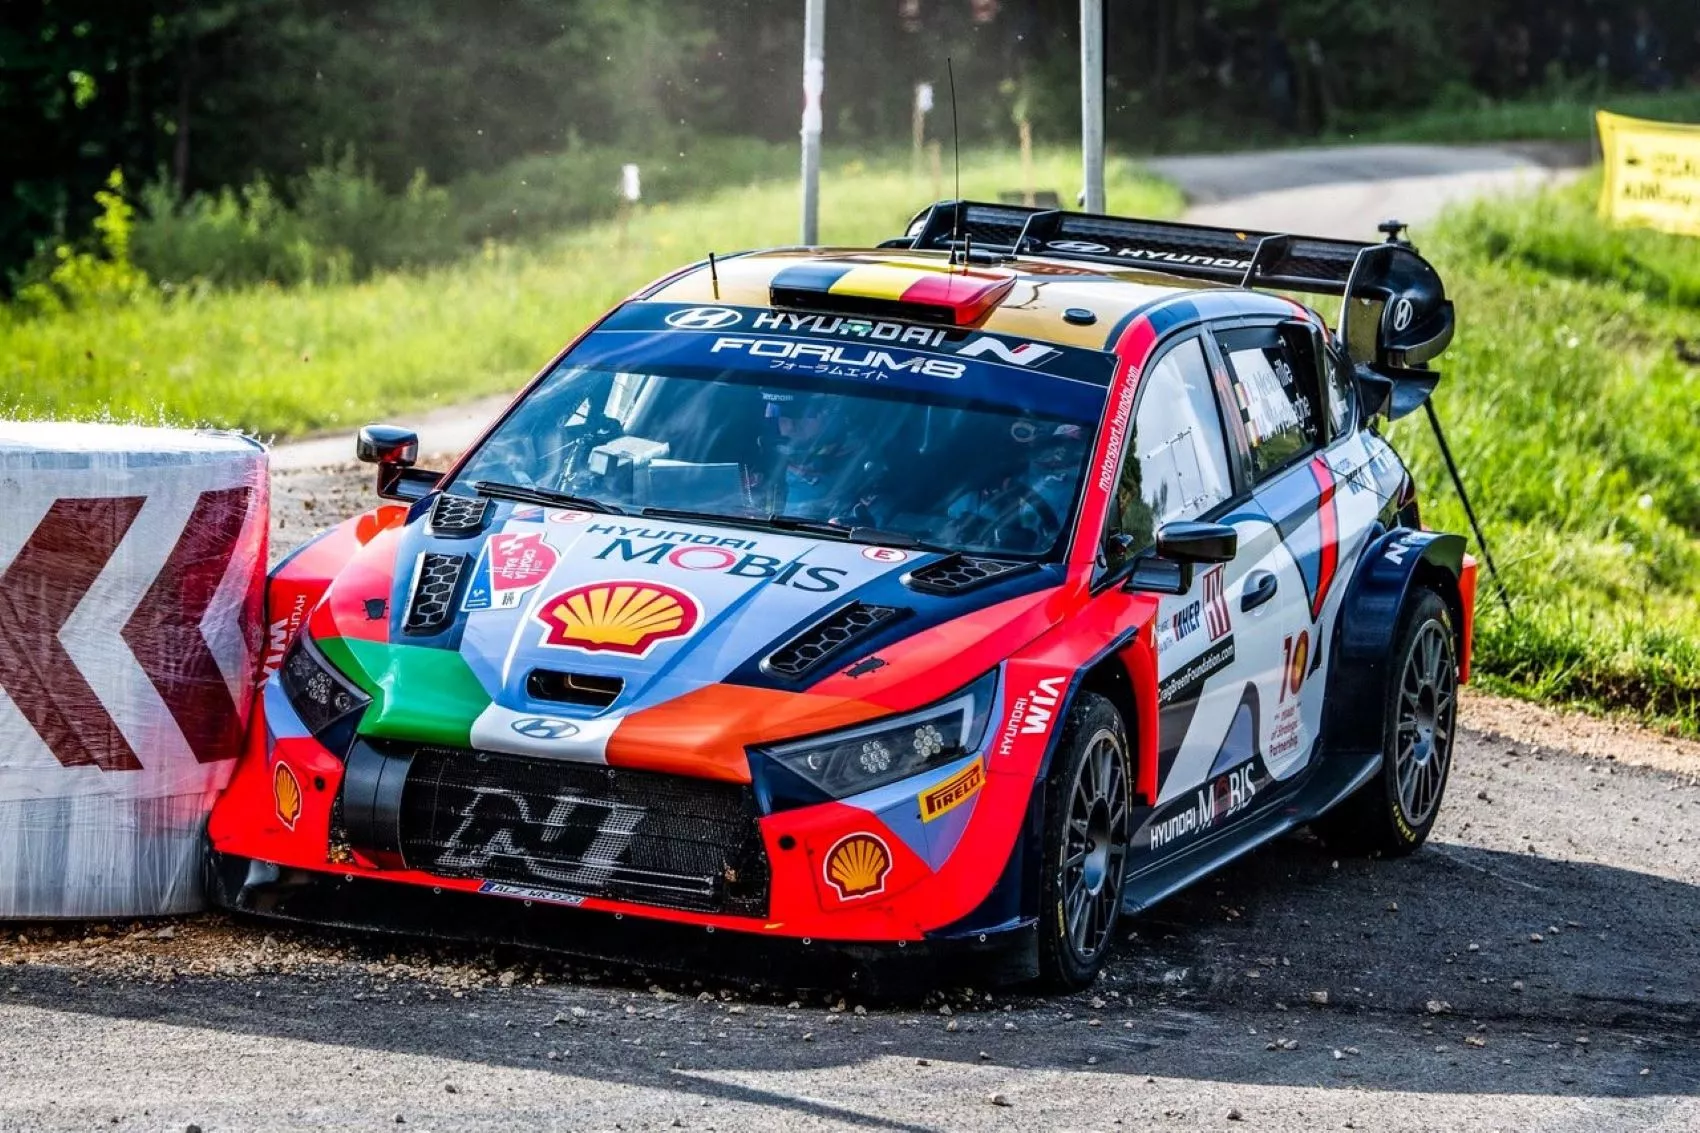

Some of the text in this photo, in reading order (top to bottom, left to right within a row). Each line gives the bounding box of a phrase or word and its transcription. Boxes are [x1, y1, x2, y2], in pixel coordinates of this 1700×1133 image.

[752, 311, 947, 348] HYUNDAI
[711, 337, 967, 380] FORUM8
[769, 359, 890, 380] フォーラムエイト
[1099, 364, 1139, 494] motorsport.hyundai.com
[587, 523, 758, 551] HYUNDAI
[593, 538, 850, 593] MOBIS
[1000, 697, 1027, 756] HYUNDAI
[1021, 676, 1067, 735] WIA
[925, 764, 982, 816] PIRELLI
[1196, 762, 1256, 824] MOBIS
[1151, 806, 1196, 851] HYUNDAI
